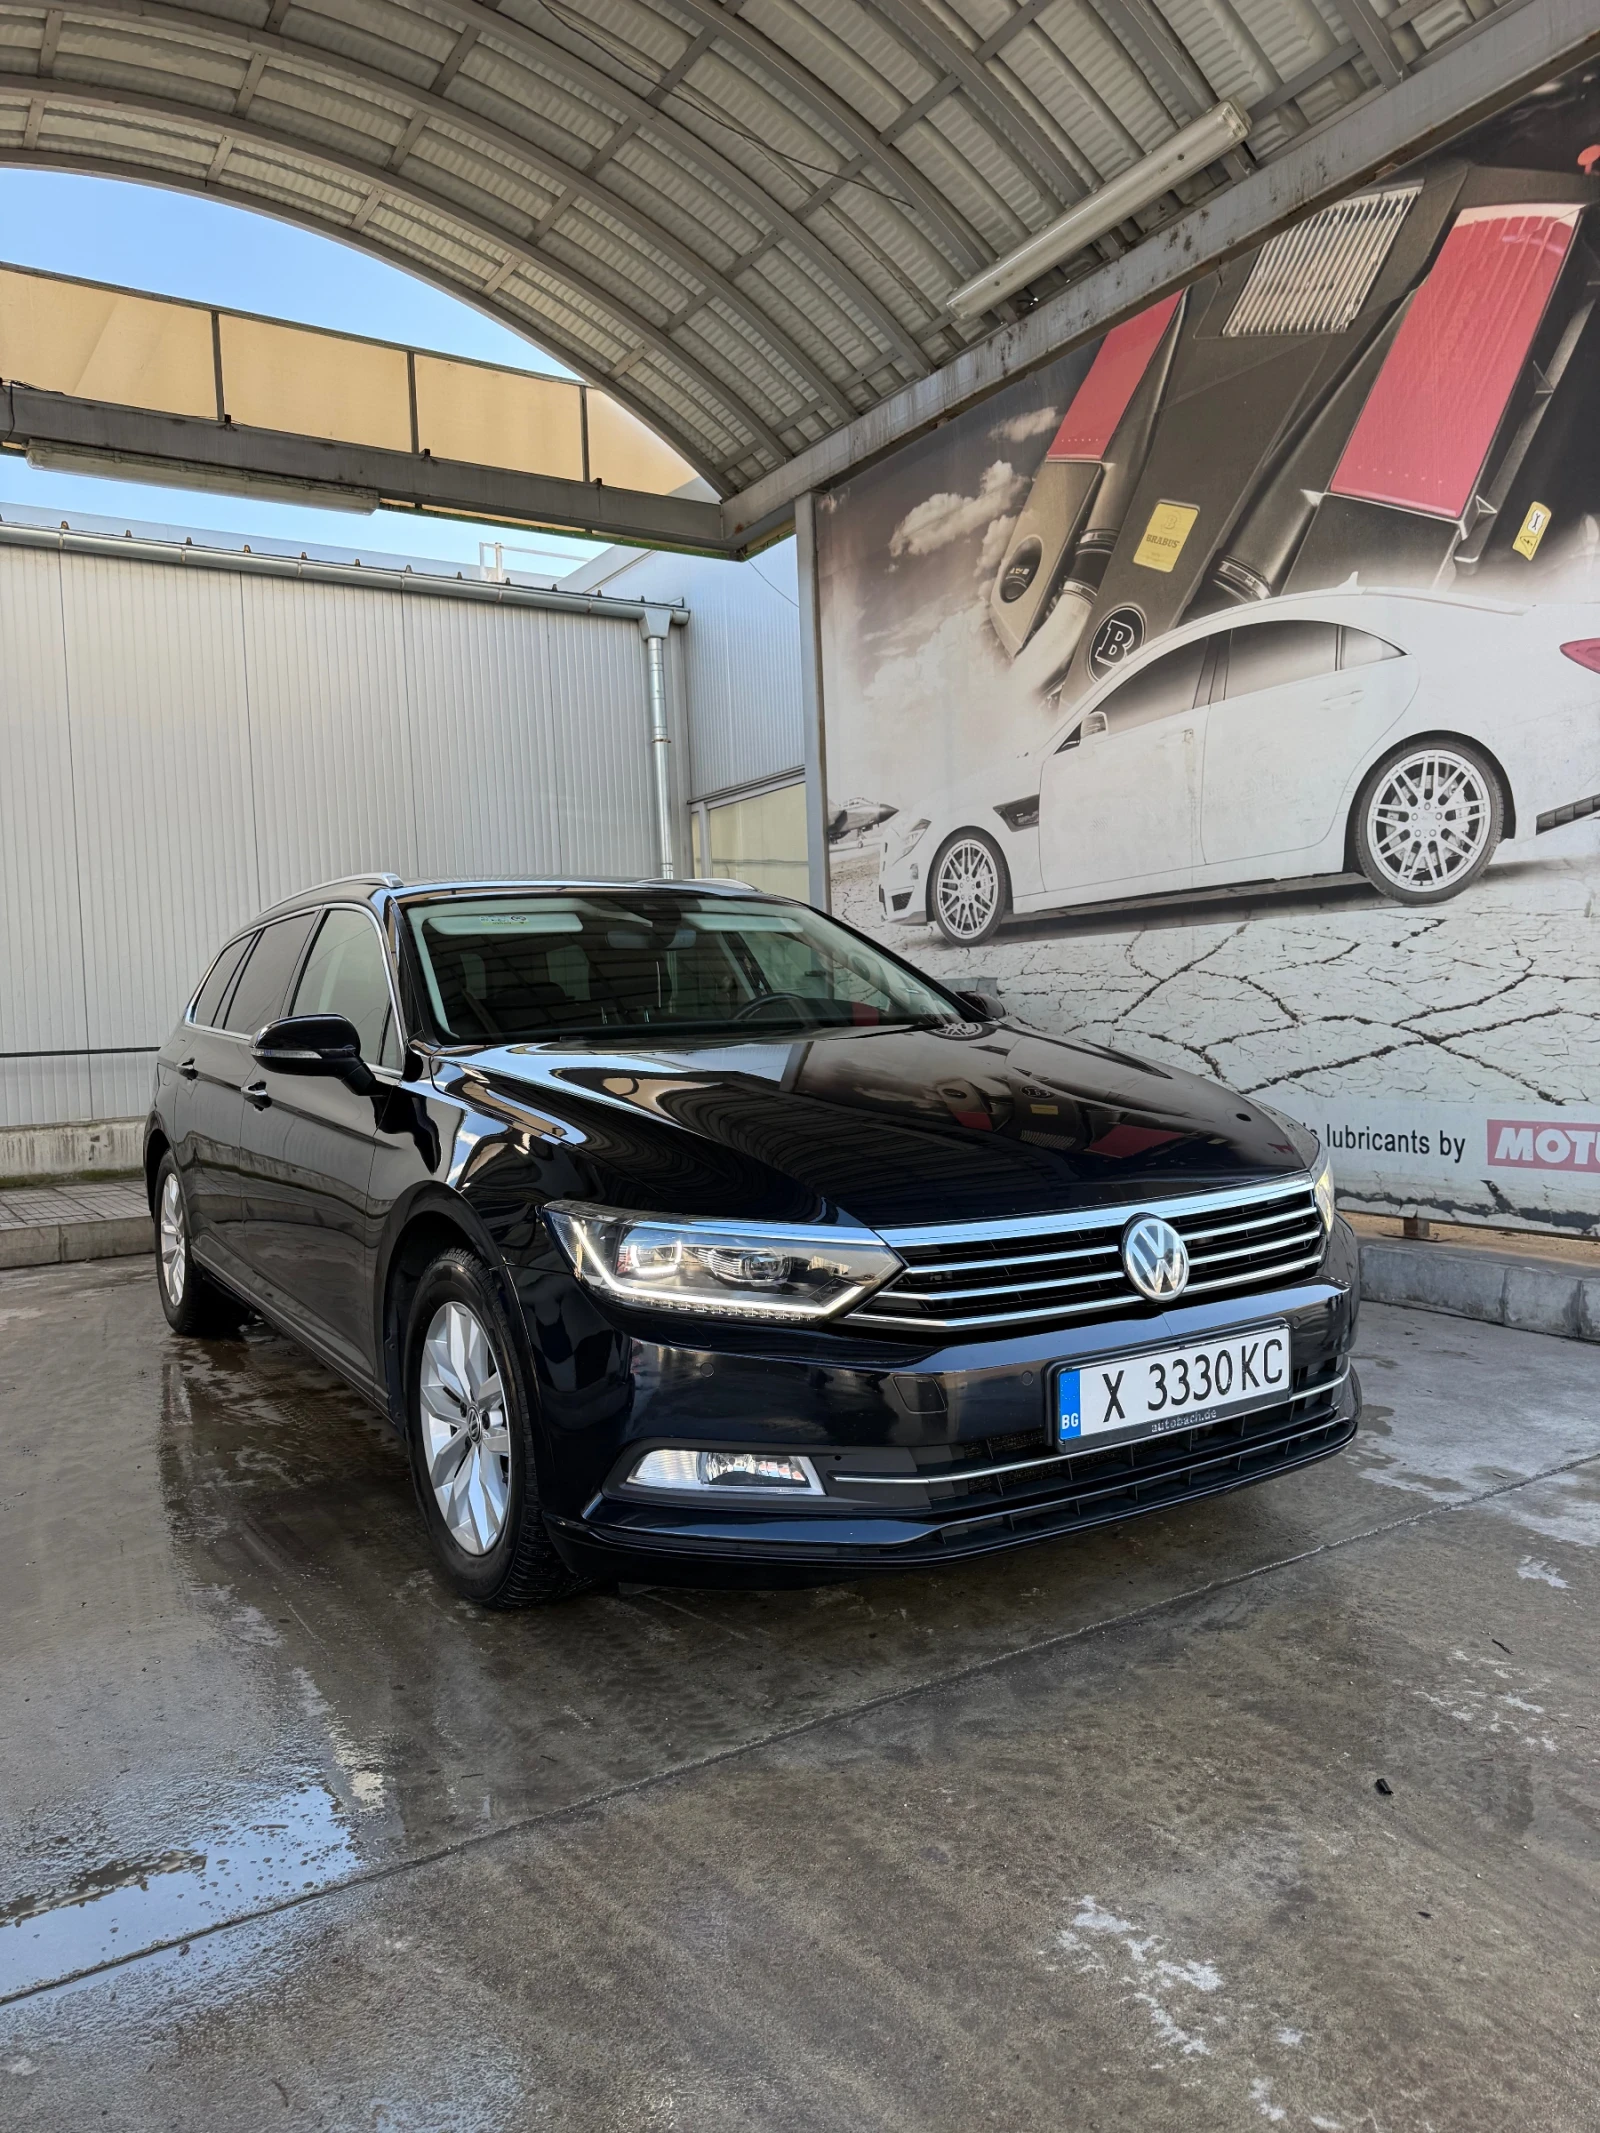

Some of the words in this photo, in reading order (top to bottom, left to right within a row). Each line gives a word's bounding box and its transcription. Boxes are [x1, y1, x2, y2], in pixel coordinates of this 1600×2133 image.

[1145, 533, 1180, 549] BRABUS
[1095, 619, 1135, 668] B
[1326, 1123, 1430, 1155] lubricants
[1439, 1130, 1466, 1164] by
[1494, 1127, 1600, 1166] MOT
[1102, 1370, 1126, 1423] X
[1061, 1412, 1079, 1430] BG
[1151, 1409, 1217, 1433] autobach.de
